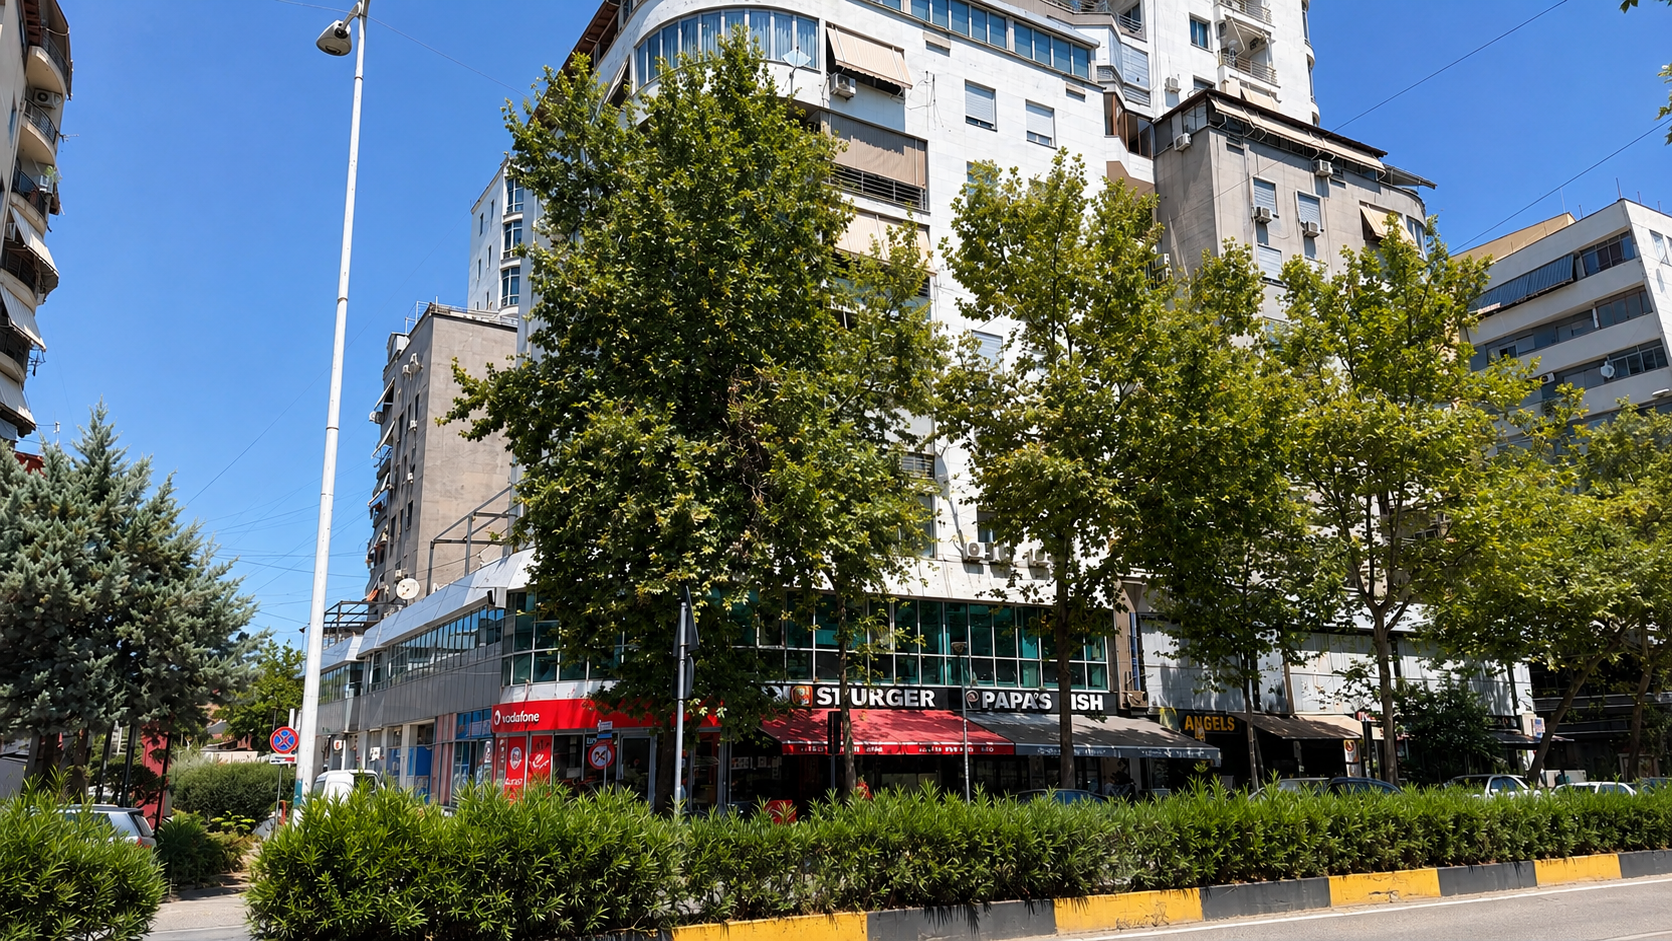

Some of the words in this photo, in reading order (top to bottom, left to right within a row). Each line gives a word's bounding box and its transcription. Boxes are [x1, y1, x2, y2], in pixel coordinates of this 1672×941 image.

[982, 691, 1053, 709] PAPA'S
[1070, 693, 1104, 711] ISH
[502, 710, 540, 723] vodafone
[1184, 714, 1235, 732] ANGELS
